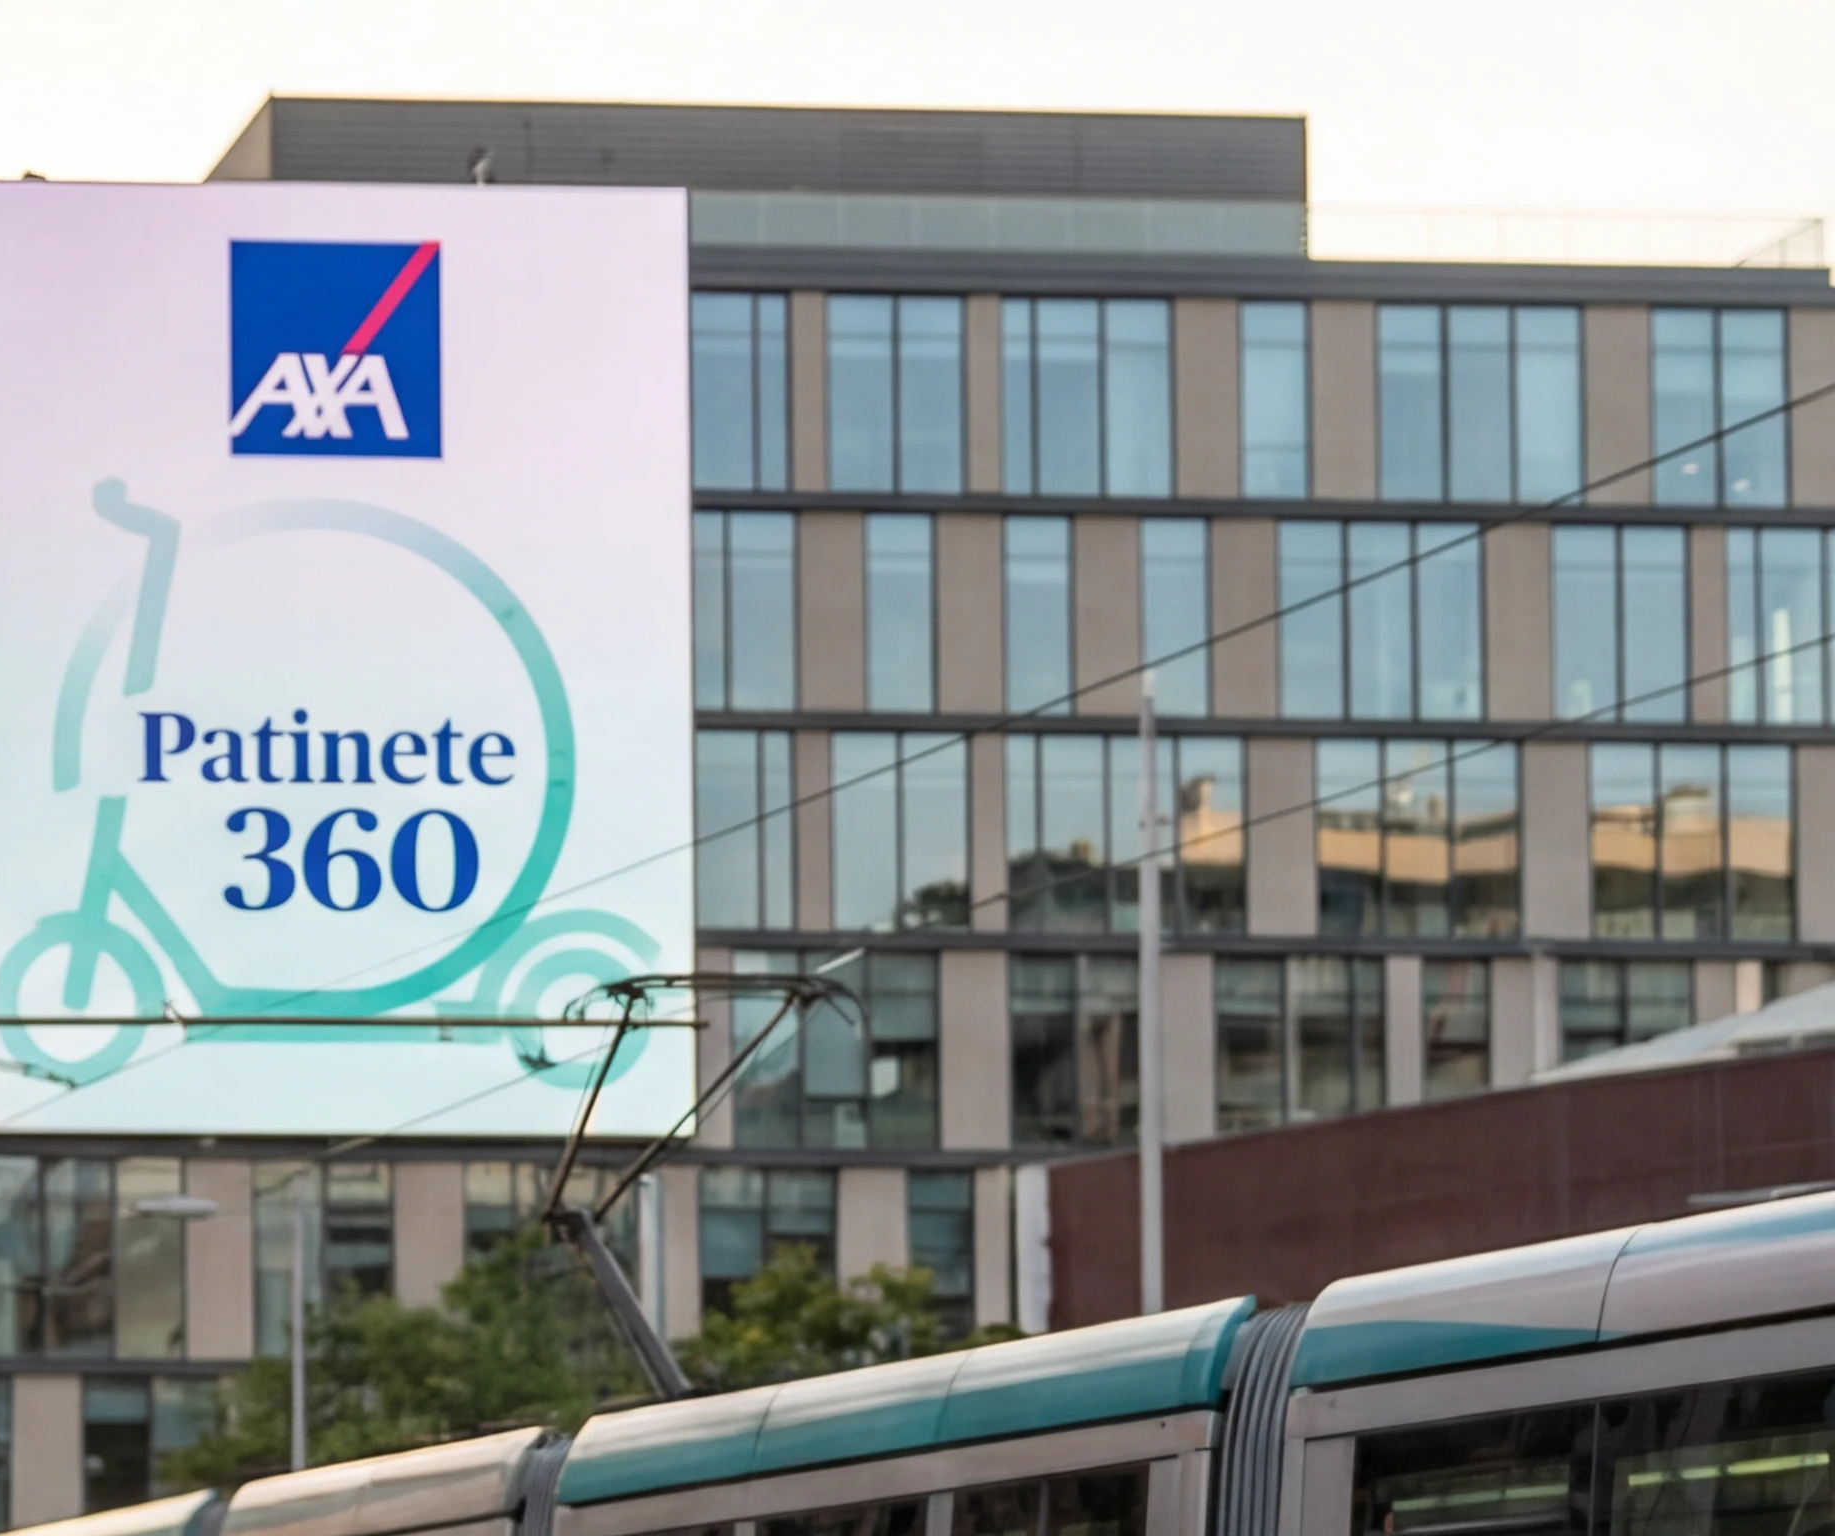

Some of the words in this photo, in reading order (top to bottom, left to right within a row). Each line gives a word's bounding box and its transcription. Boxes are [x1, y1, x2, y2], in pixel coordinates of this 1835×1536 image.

[230, 352, 410, 440] AXA
[138, 708, 517, 786] Patinete
[223, 806, 480, 913] 360
